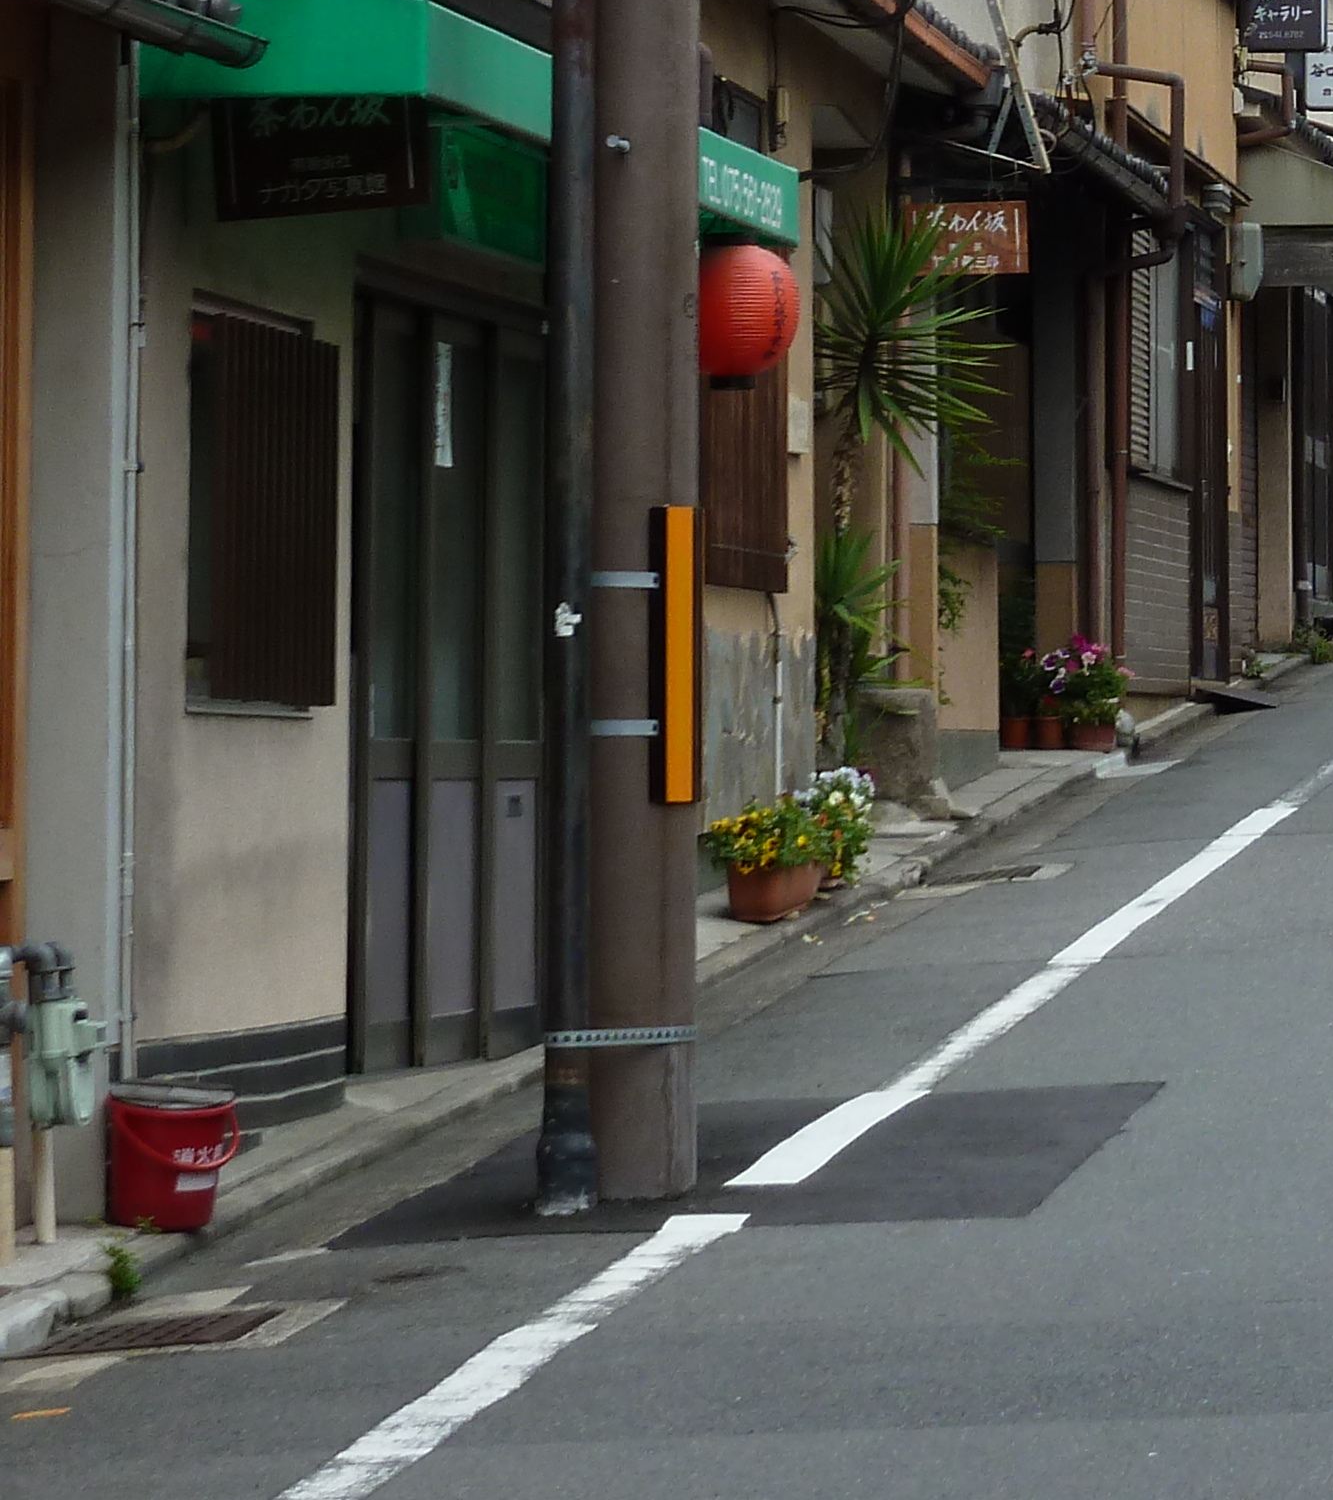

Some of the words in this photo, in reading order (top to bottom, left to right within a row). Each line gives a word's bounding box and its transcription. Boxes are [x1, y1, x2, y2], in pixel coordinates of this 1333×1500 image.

[1254, 4, 1313, 22] ギャラリー
